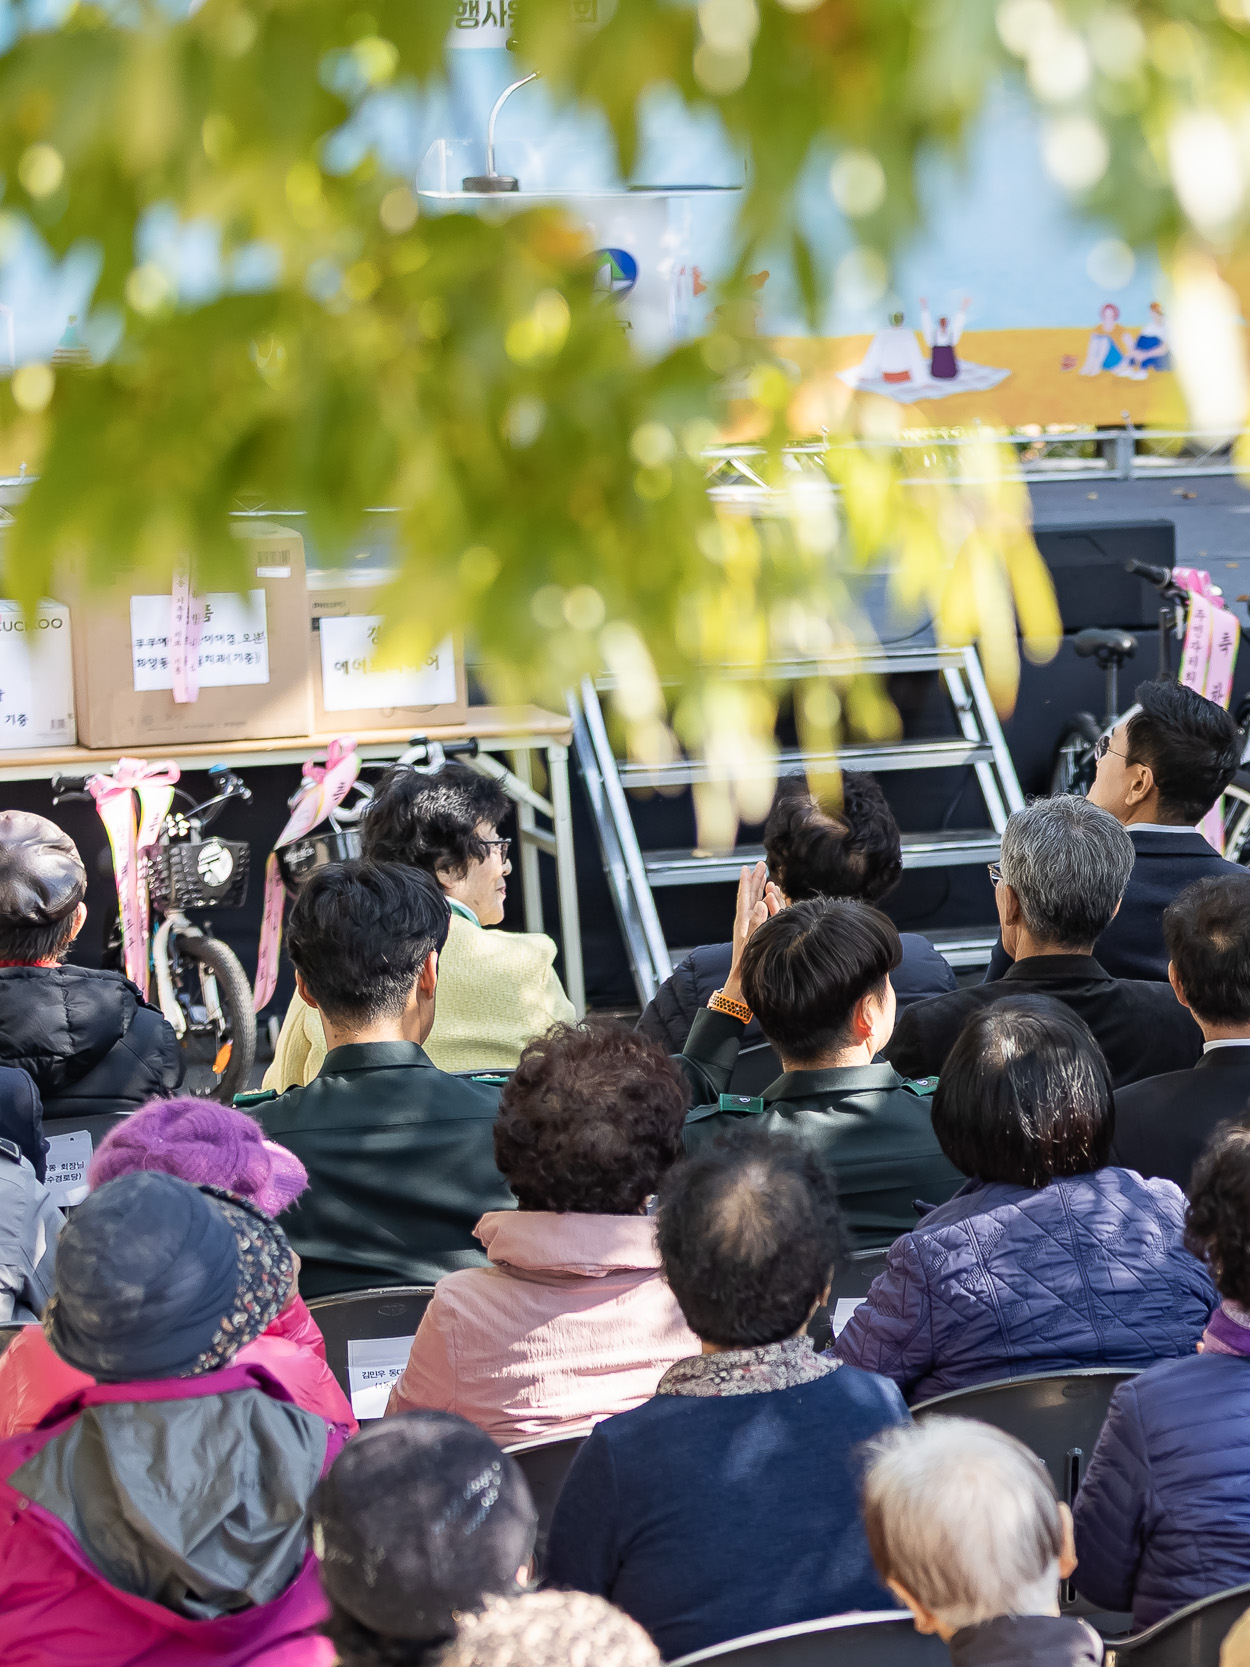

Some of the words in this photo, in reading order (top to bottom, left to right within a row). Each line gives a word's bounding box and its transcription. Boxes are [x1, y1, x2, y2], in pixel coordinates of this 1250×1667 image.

[0, 618, 63, 632] UCOO
[61, 1161, 84, 1171] 회장님
[45, 1172, 81, 1183] 수경로당)
